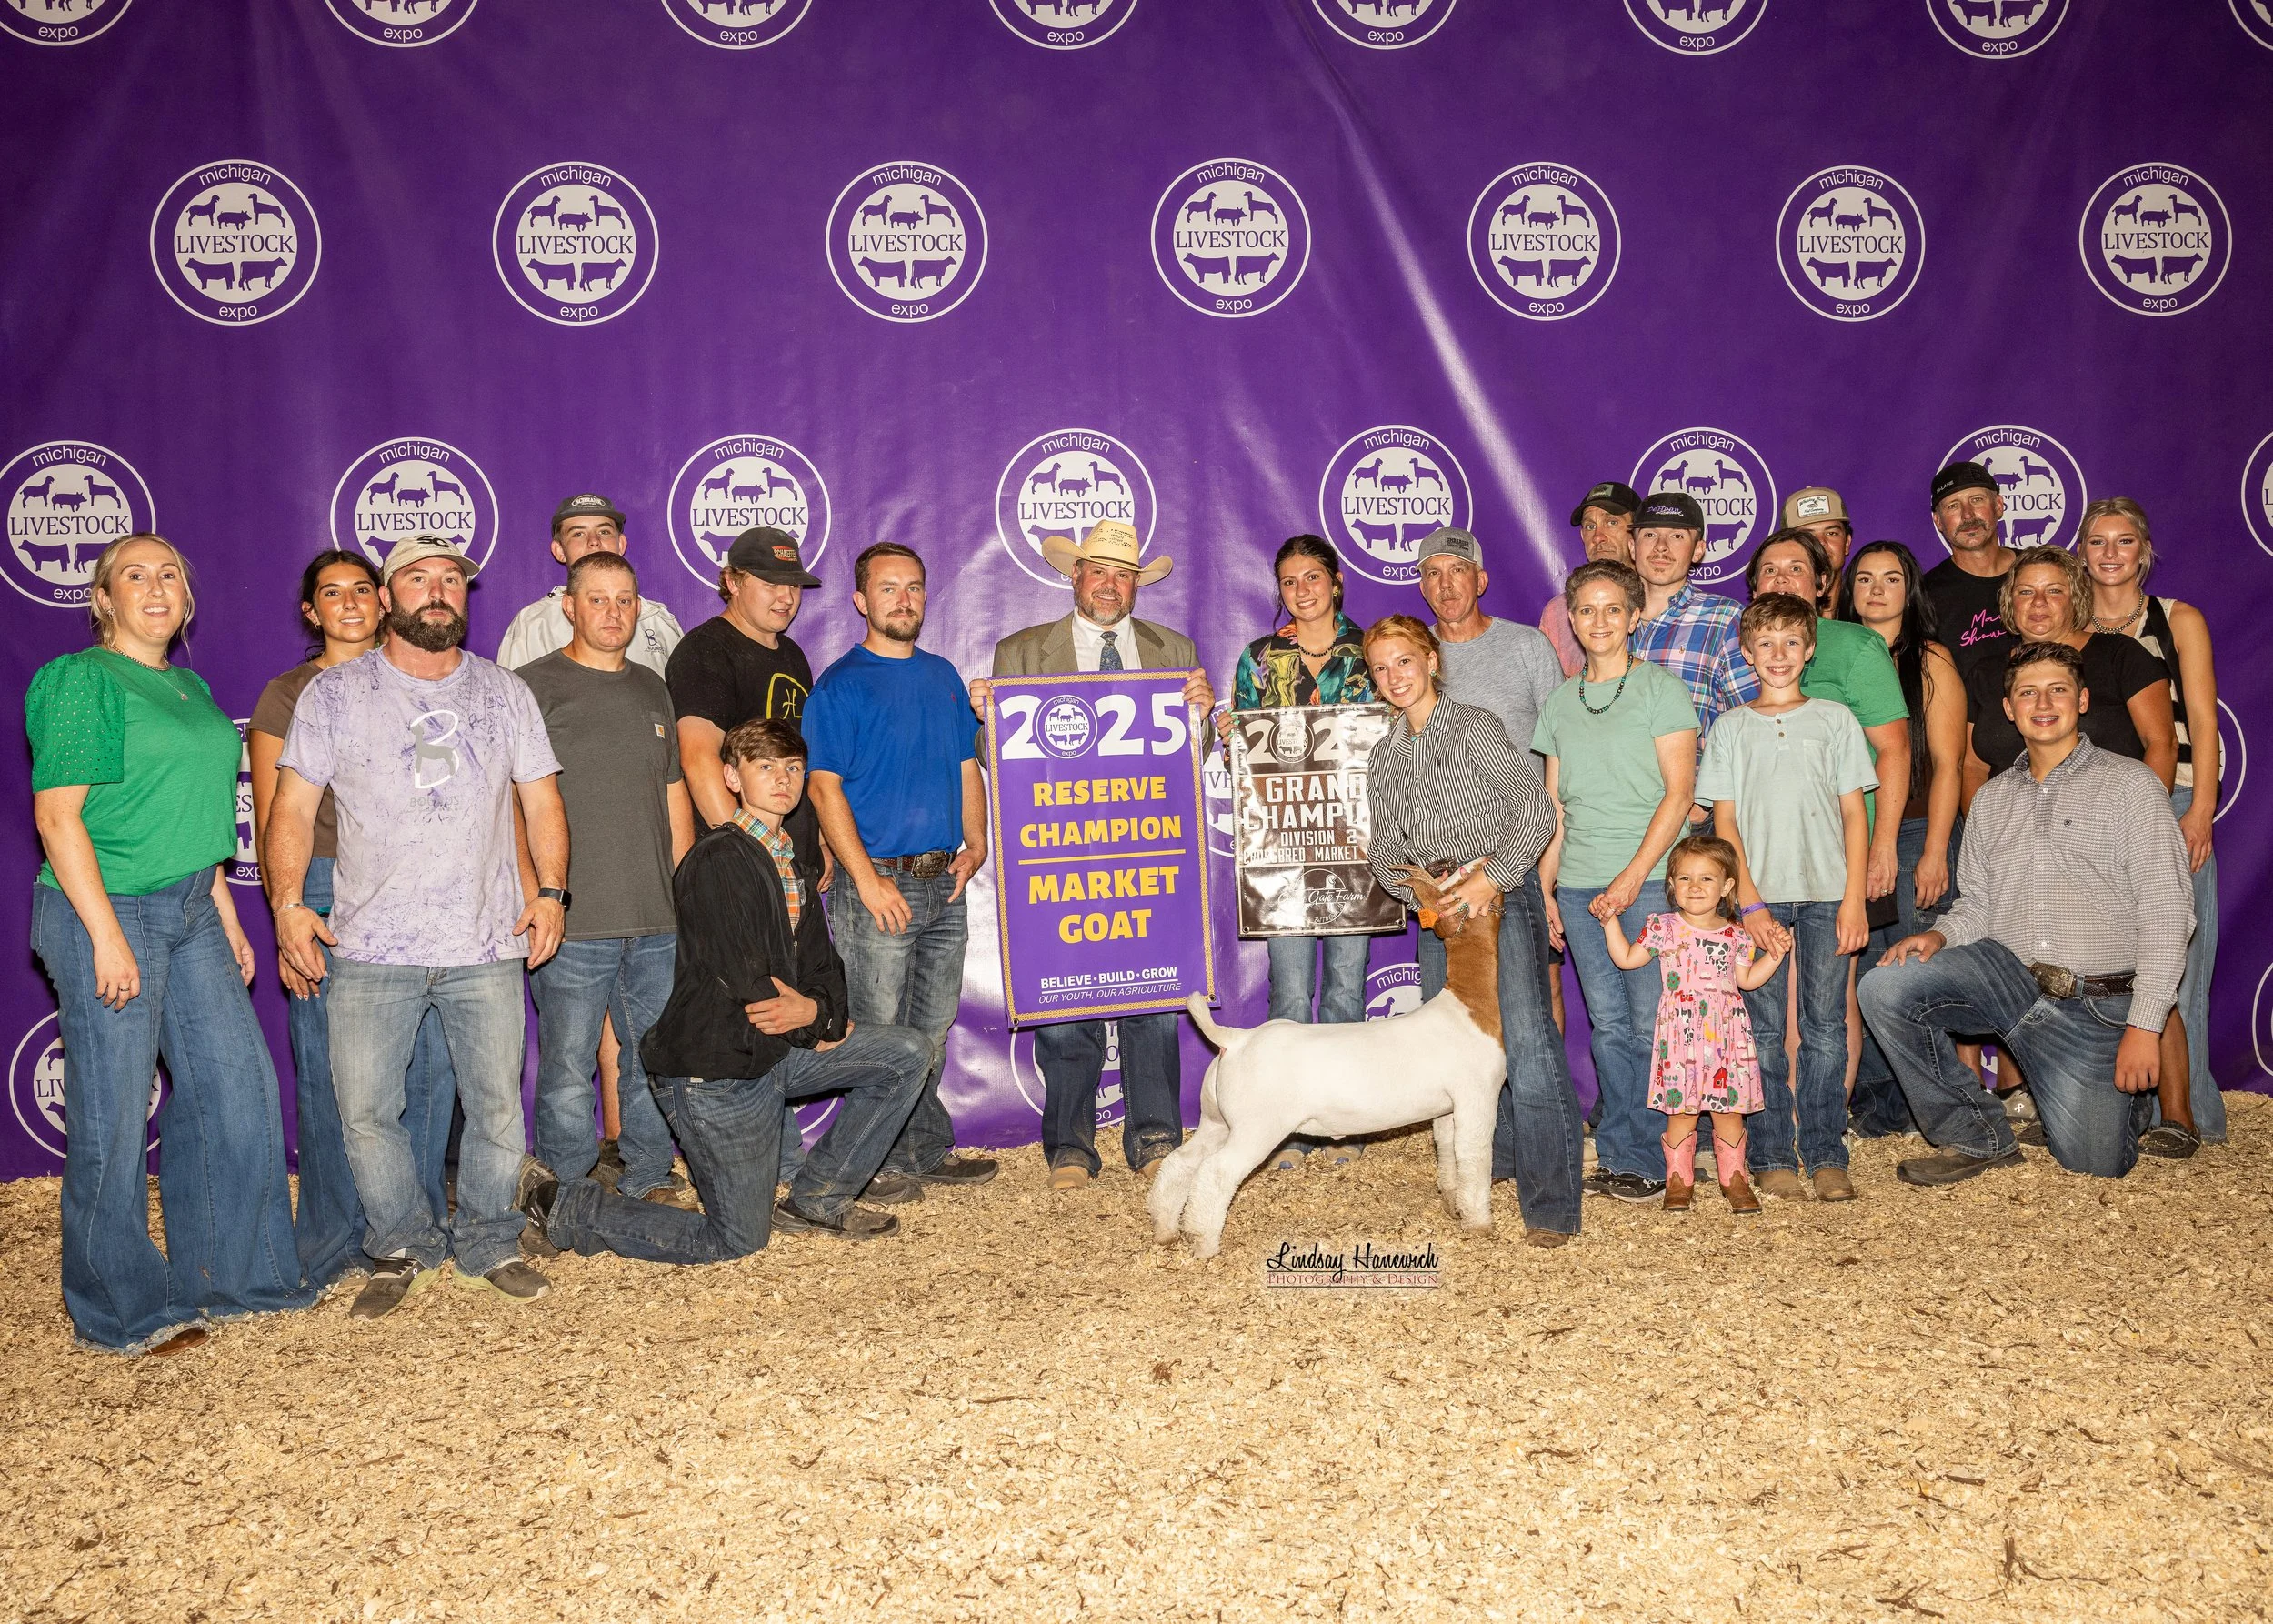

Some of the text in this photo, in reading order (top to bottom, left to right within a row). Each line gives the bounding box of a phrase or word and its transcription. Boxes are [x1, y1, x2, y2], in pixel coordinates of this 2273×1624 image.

[38, 25, 79, 42] expo
[383, 27, 423, 43] expo
[719, 30, 758, 45] expo
[1046, 31, 1085, 46] expo
[1367, 30, 1405, 45] expo
[1679, 35, 1715, 52] expo
[1981, 40, 2018, 55] expo
[198, 164, 271, 185] michigan
[540, 165, 612, 187] michigan
[872, 165, 942, 186] michigan
[1197, 162, 1265, 184] michigan
[1511, 165, 1577, 187] michigan
[1818, 169, 1884, 190] michigan
[2124, 165, 2189, 188] michigan
[175, 234, 295, 254] LIVESTOCK
[517, 236, 634, 255] LIVESTOCK
[850, 233, 964, 253] LIVESTOCK
[1176, 229, 1287, 249] LIVESTOCK
[1490, 233, 1598, 252] LIVESTOCK
[1798, 236, 1903, 254] LIVESTOCK
[2103, 231, 2209, 250] LIVESTOCK
[218, 306, 258, 322] expo
[559, 306, 598, 322] expo
[891, 303, 929, 318] expo
[1215, 298, 1253, 314] expo
[1528, 302, 1565, 316] expo
[1835, 303, 1870, 318] expo
[2142, 297, 2178, 313] expo
[1041, 433, 1110, 454] michigan
[1363, 428, 1430, 451] michigan
[1669, 431, 1735, 452] michigan
[1974, 428, 2041, 449] michigan
[32, 444, 107, 467] michigan
[379, 441, 450, 464] michigan
[714, 438, 785, 460] michigan
[1019, 500, 1133, 520] LIVESTOCK
[1343, 496, 1451, 516] LIVESTOCK
[2001, 492, 2063, 511] STOCK
[9, 515, 130, 536] LIVESTOCK
[356, 511, 473, 532] LIVESTOCK
[692, 506, 806, 526] LIVESTOCK
[1052, 696, 1081, 706] michigan
[1045, 722, 1089, 733] LIVESTOCK
[1061, 749, 1077, 757] expo
[1032, 776, 1167, 807] RESERVE
[1265, 773, 1367, 803] GRAND
[1242, 800, 1371, 830] CHAMPIO
[1019, 815, 1183, 848] CHAMPION
[1280, 828, 1357, 847] DIVISION 2
[1315, 845, 1358, 862] MARKET
[236, 866, 262, 881] exp
[1028, 866, 1181, 905] MARKET
[1335, 889, 1366, 905] Farm
[1058, 909, 1152, 945] GOAT
[1376, 967, 1422, 989] michig
[1038, 982, 1183, 1004] OUR YOUTH, OUR AGRICULTURE
